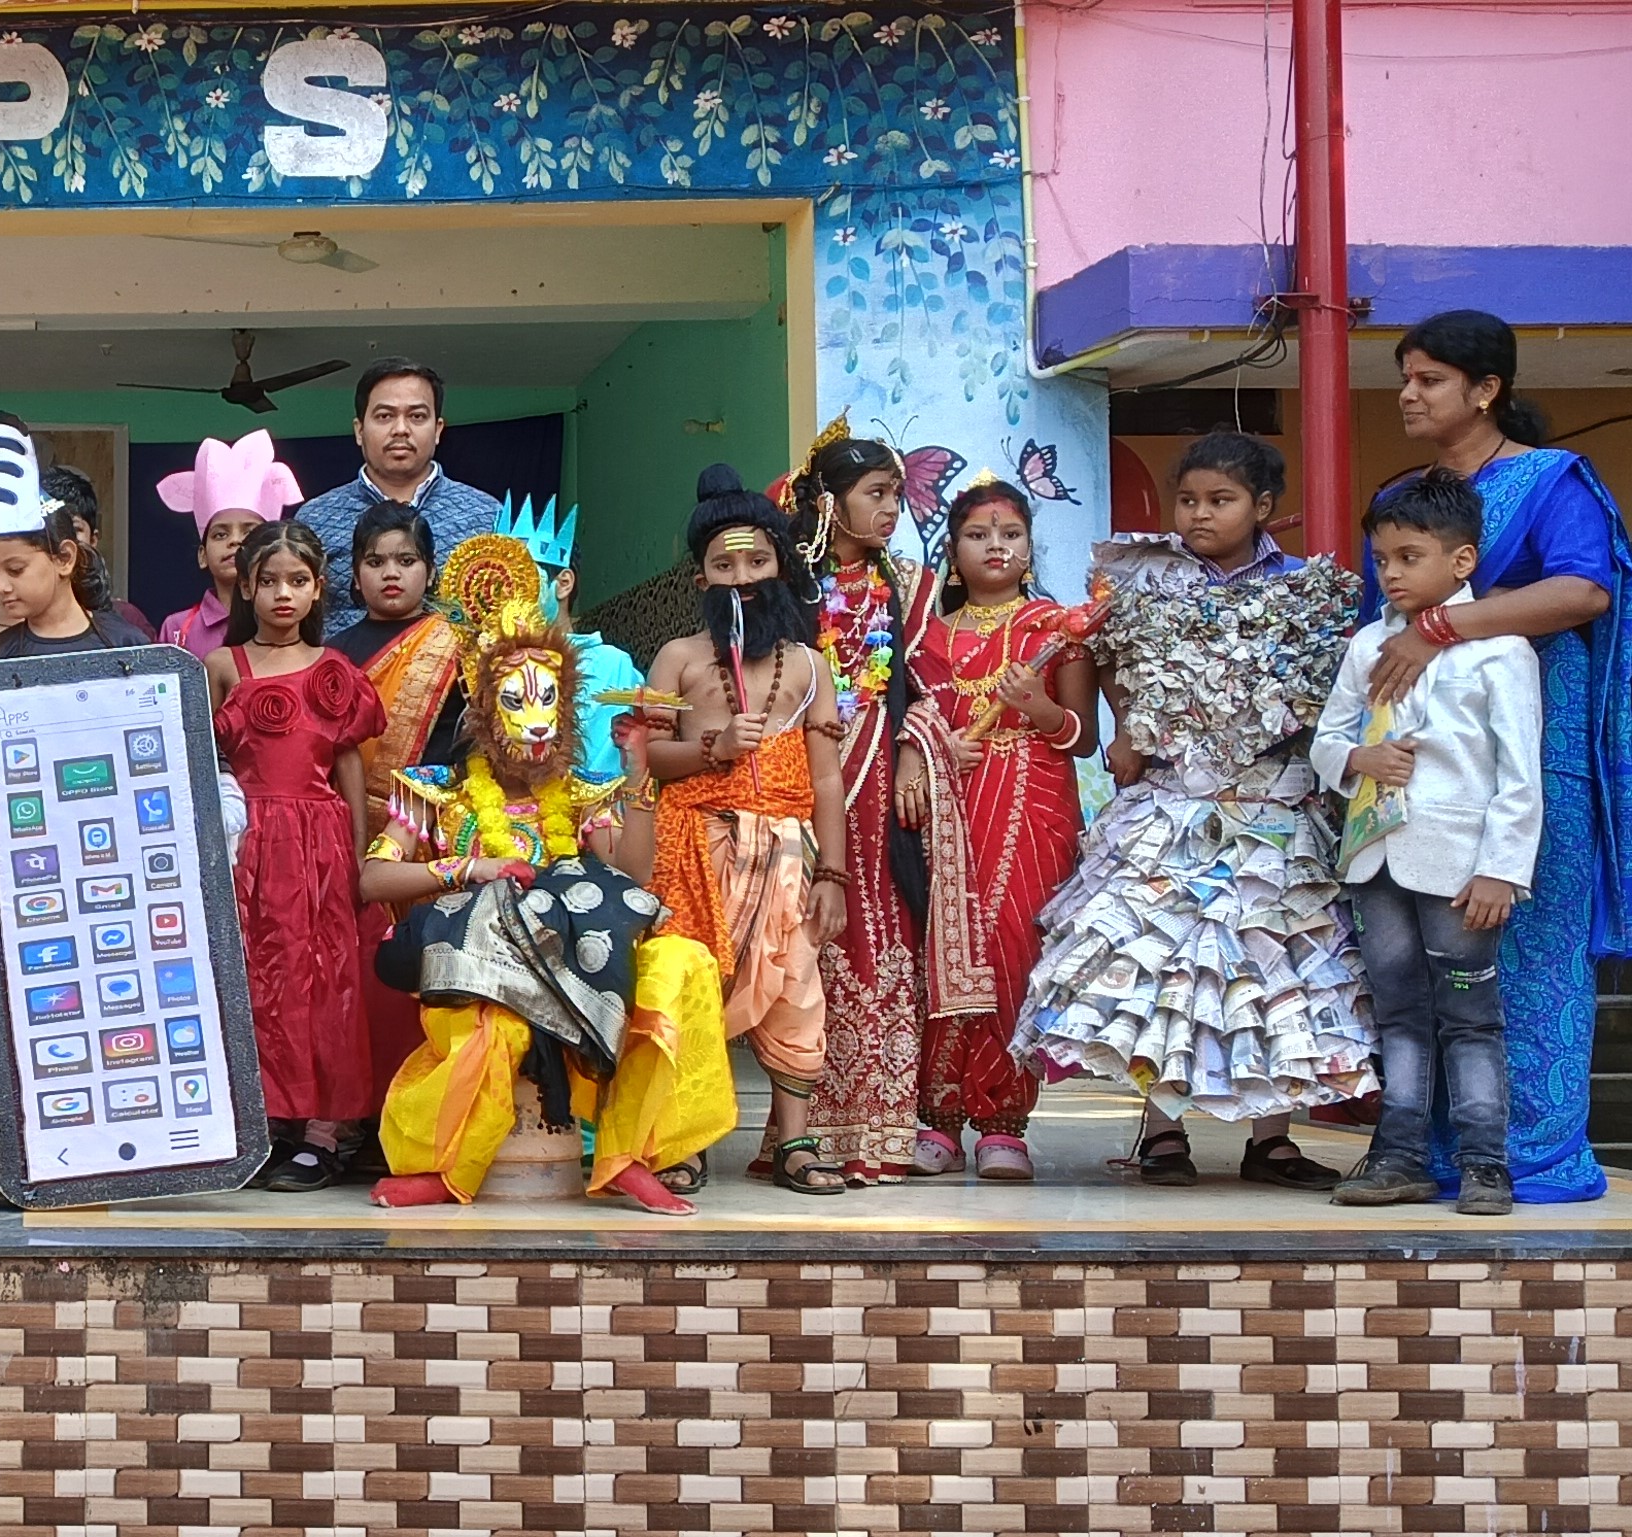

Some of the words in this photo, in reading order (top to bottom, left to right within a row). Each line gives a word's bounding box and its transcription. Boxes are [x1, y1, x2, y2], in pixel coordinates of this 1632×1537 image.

[264, 38, 388, 178] S
[106, 1055, 155, 1066] Instagram
[47, 1064, 79, 1074] Phone
